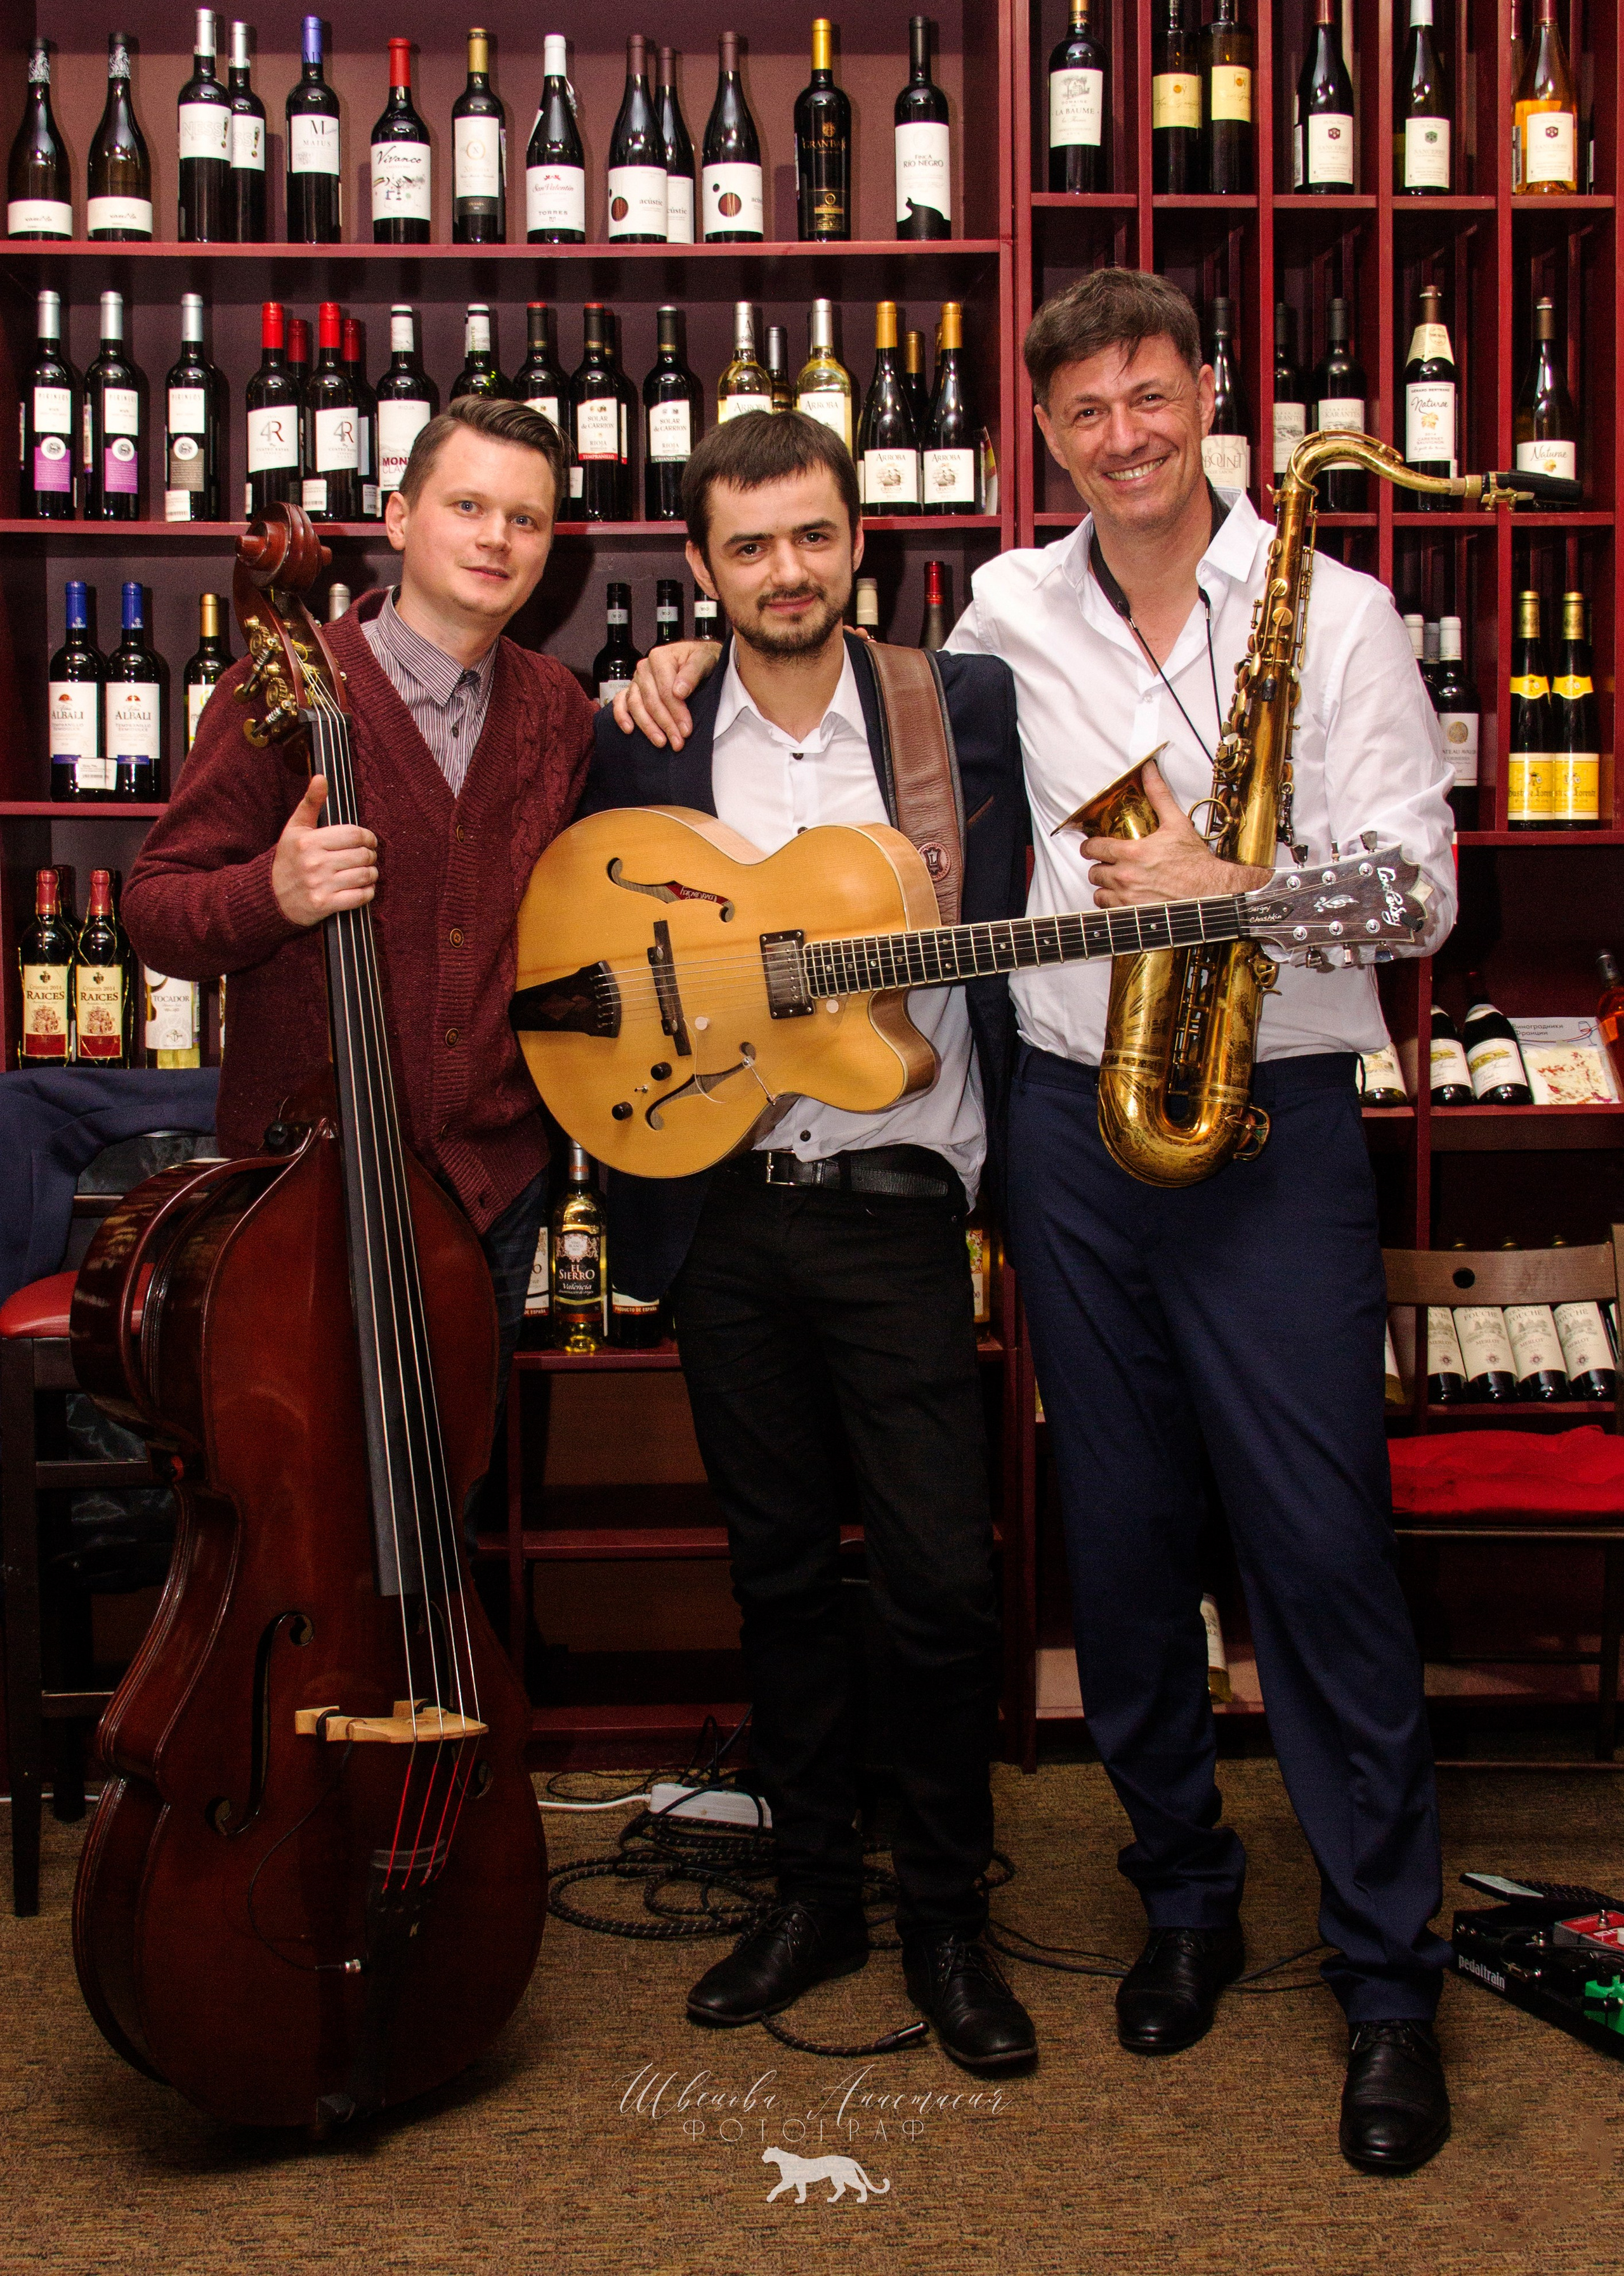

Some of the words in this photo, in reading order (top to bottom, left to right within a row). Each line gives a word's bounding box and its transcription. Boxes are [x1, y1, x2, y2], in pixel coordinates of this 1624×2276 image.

[376, 145, 422, 166] Vivanco
[918, 159, 944, 167] NEGRO
[667, 207, 688, 215] cústic
[805, 400, 839, 411] ARROBA
[876, 453, 906, 462] ARROBA
[1530, 445, 1567, 461] Naturae
[382, 457, 410, 466] MON
[932, 454, 961, 462] ARROBA
[51, 711, 84, 720] ALBALI
[115, 711, 152, 721] ALBALI
[1249, 913, 1282, 923] Chashkin
[27, 990, 65, 1001] RAICES
[81, 991, 119, 1002] RAICES
[153, 995, 190, 1003] TOCADOR
[571, 1264, 580, 1272] EL
[559, 1269, 596, 1281] SIERRO
[562, 1282, 593, 1290] Valencia
[1458, 1954, 1505, 1989] pedaltrain
